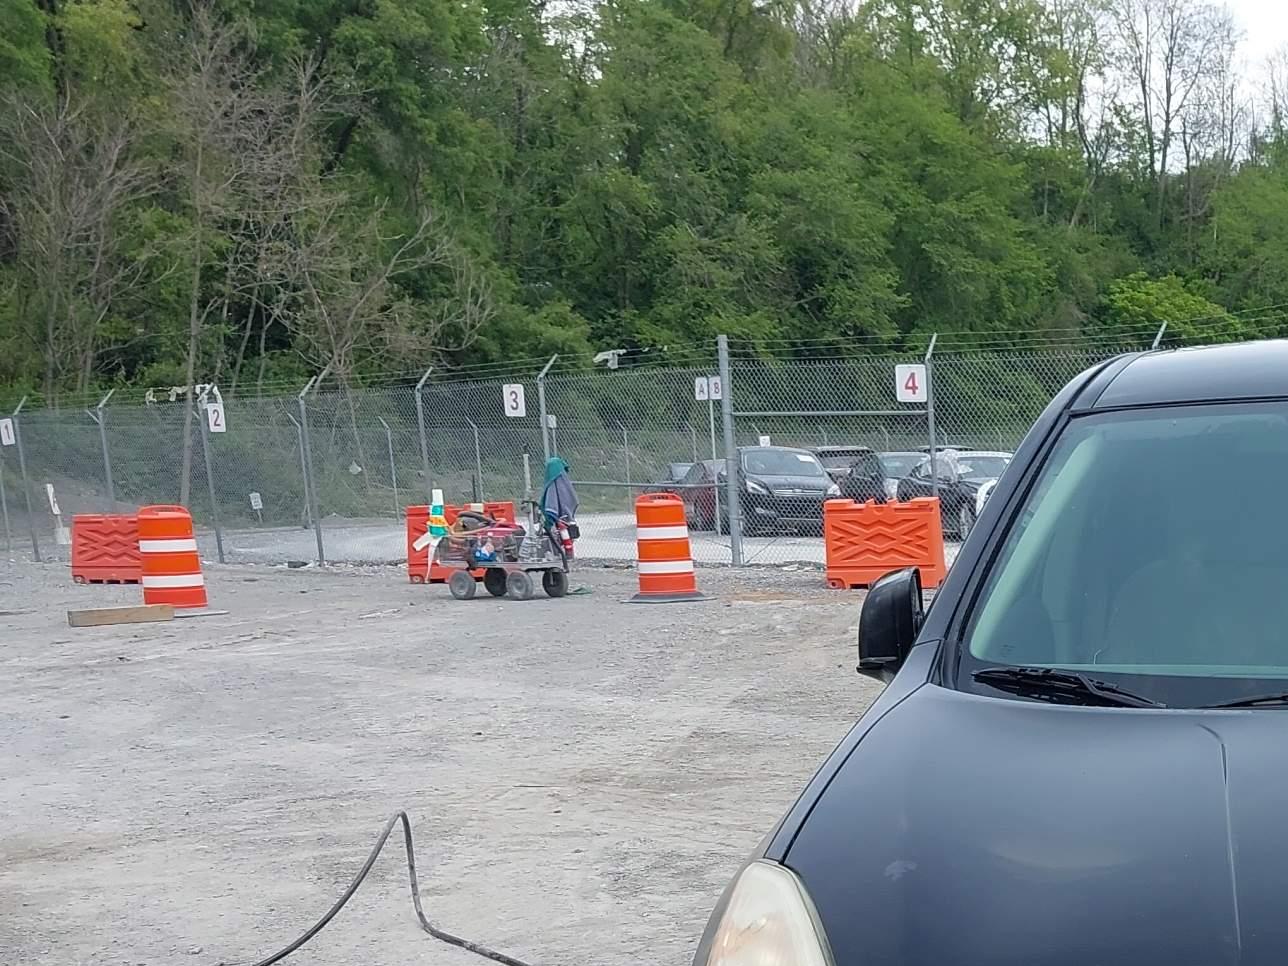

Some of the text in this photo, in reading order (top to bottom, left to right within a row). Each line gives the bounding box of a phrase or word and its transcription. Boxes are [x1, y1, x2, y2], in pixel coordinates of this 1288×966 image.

[698, 384, 705, 395] A
[713, 382, 720, 394] B
[904, 371, 919, 395] 4
[509, 390, 519, 411] 3
[212, 408, 221, 427] 2
[4, 423, 11, 441] 1
